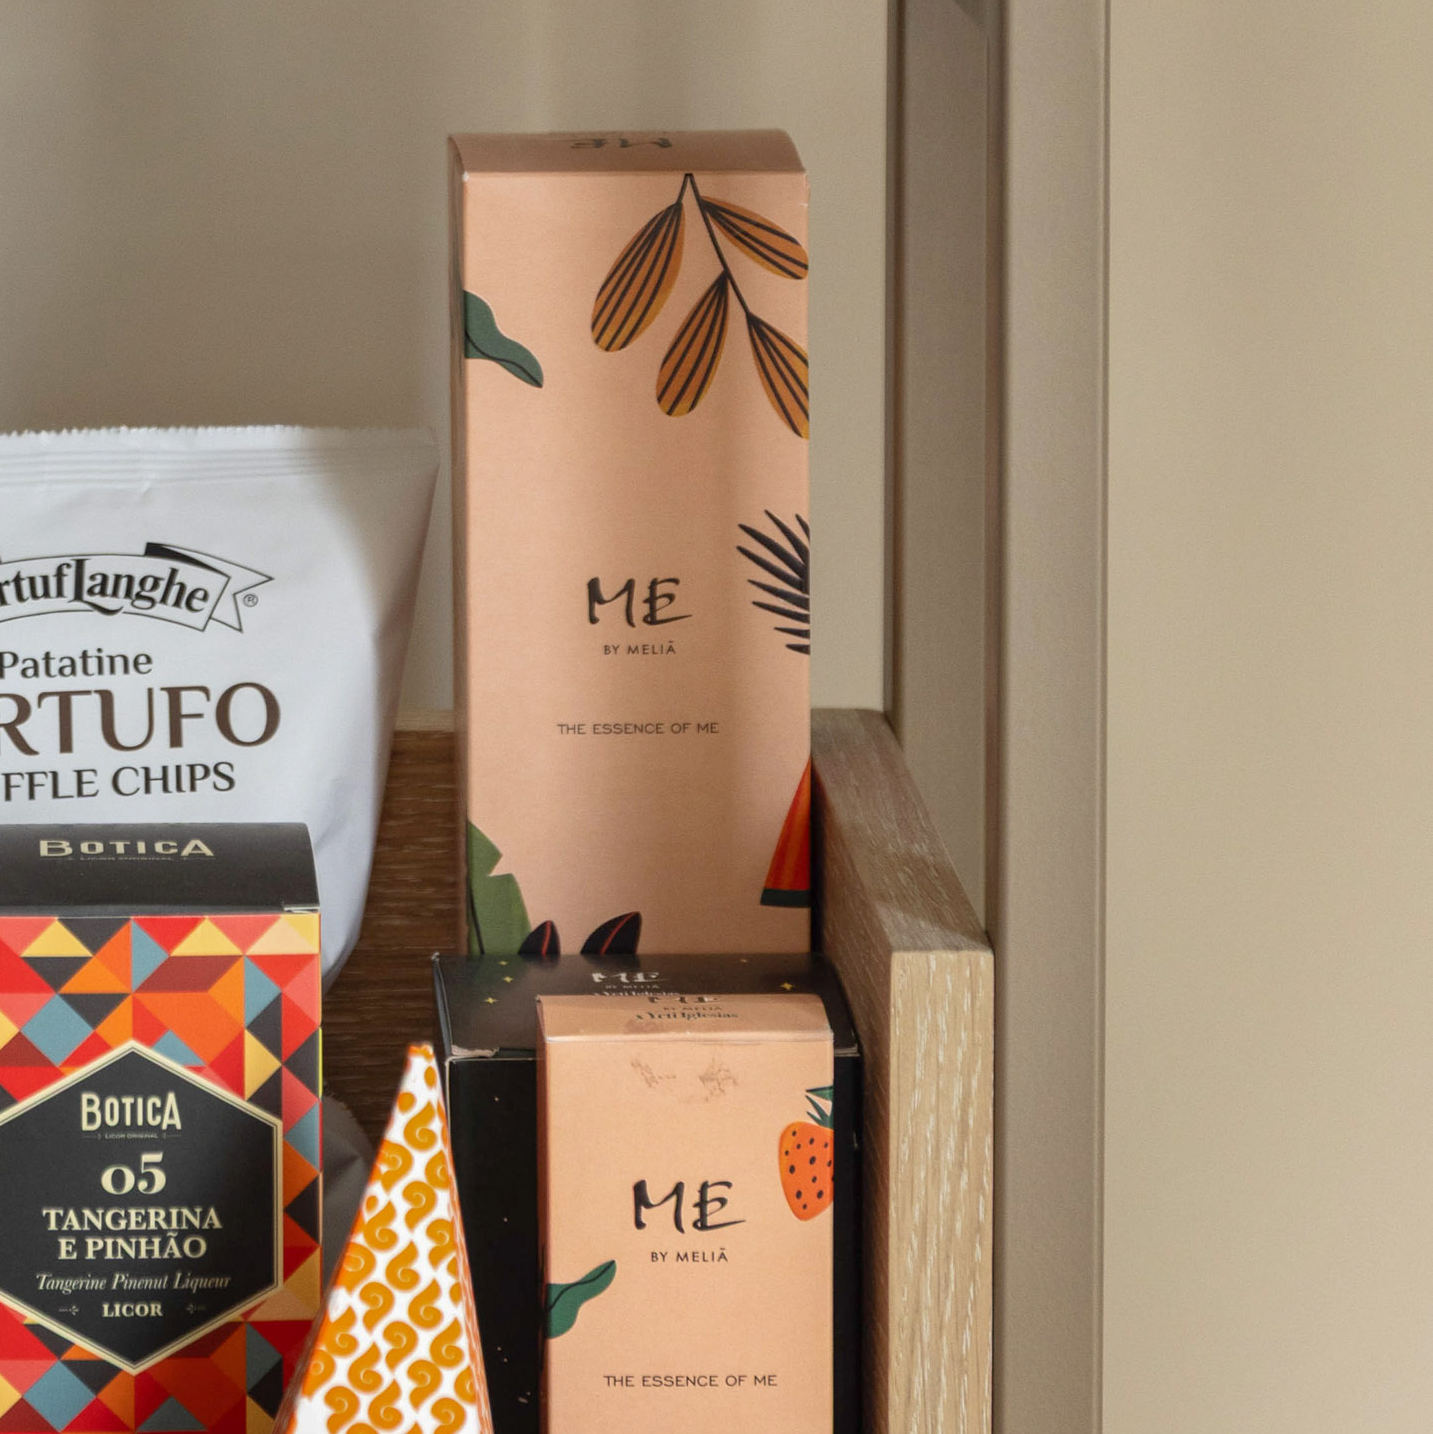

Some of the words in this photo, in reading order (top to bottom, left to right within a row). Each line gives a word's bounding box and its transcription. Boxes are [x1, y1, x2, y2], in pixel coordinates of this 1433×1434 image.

[587, 576, 693, 628] ME
[603, 644, 620, 655] BY
[557, 723, 586, 735] THE
[593, 723, 665, 735] ESSENCE
[671, 722, 691, 734] OF
[697, 722, 720, 734] ME
[111, 761, 236, 797] CHIPS
[101, 1152, 166, 1195] 05
[633, 1179, 746, 1234] ME
[42, 1207, 223, 1231] TANGERINA
[57, 1237, 78, 1260] E
[84, 1231, 207, 1260] PINHÃO
[650, 1251, 669, 1262] BY
[36, 1272, 107, 1295] Tangerine
[173, 1270, 232, 1294] Liqueur
[102, 1302, 164, 1317] LICOR
[603, 1375, 635, 1387] THE
[642, 1375, 719, 1387] ESSENCE
[725, 1375, 747, 1387] OF
[753, 1375, 778, 1386] ME
